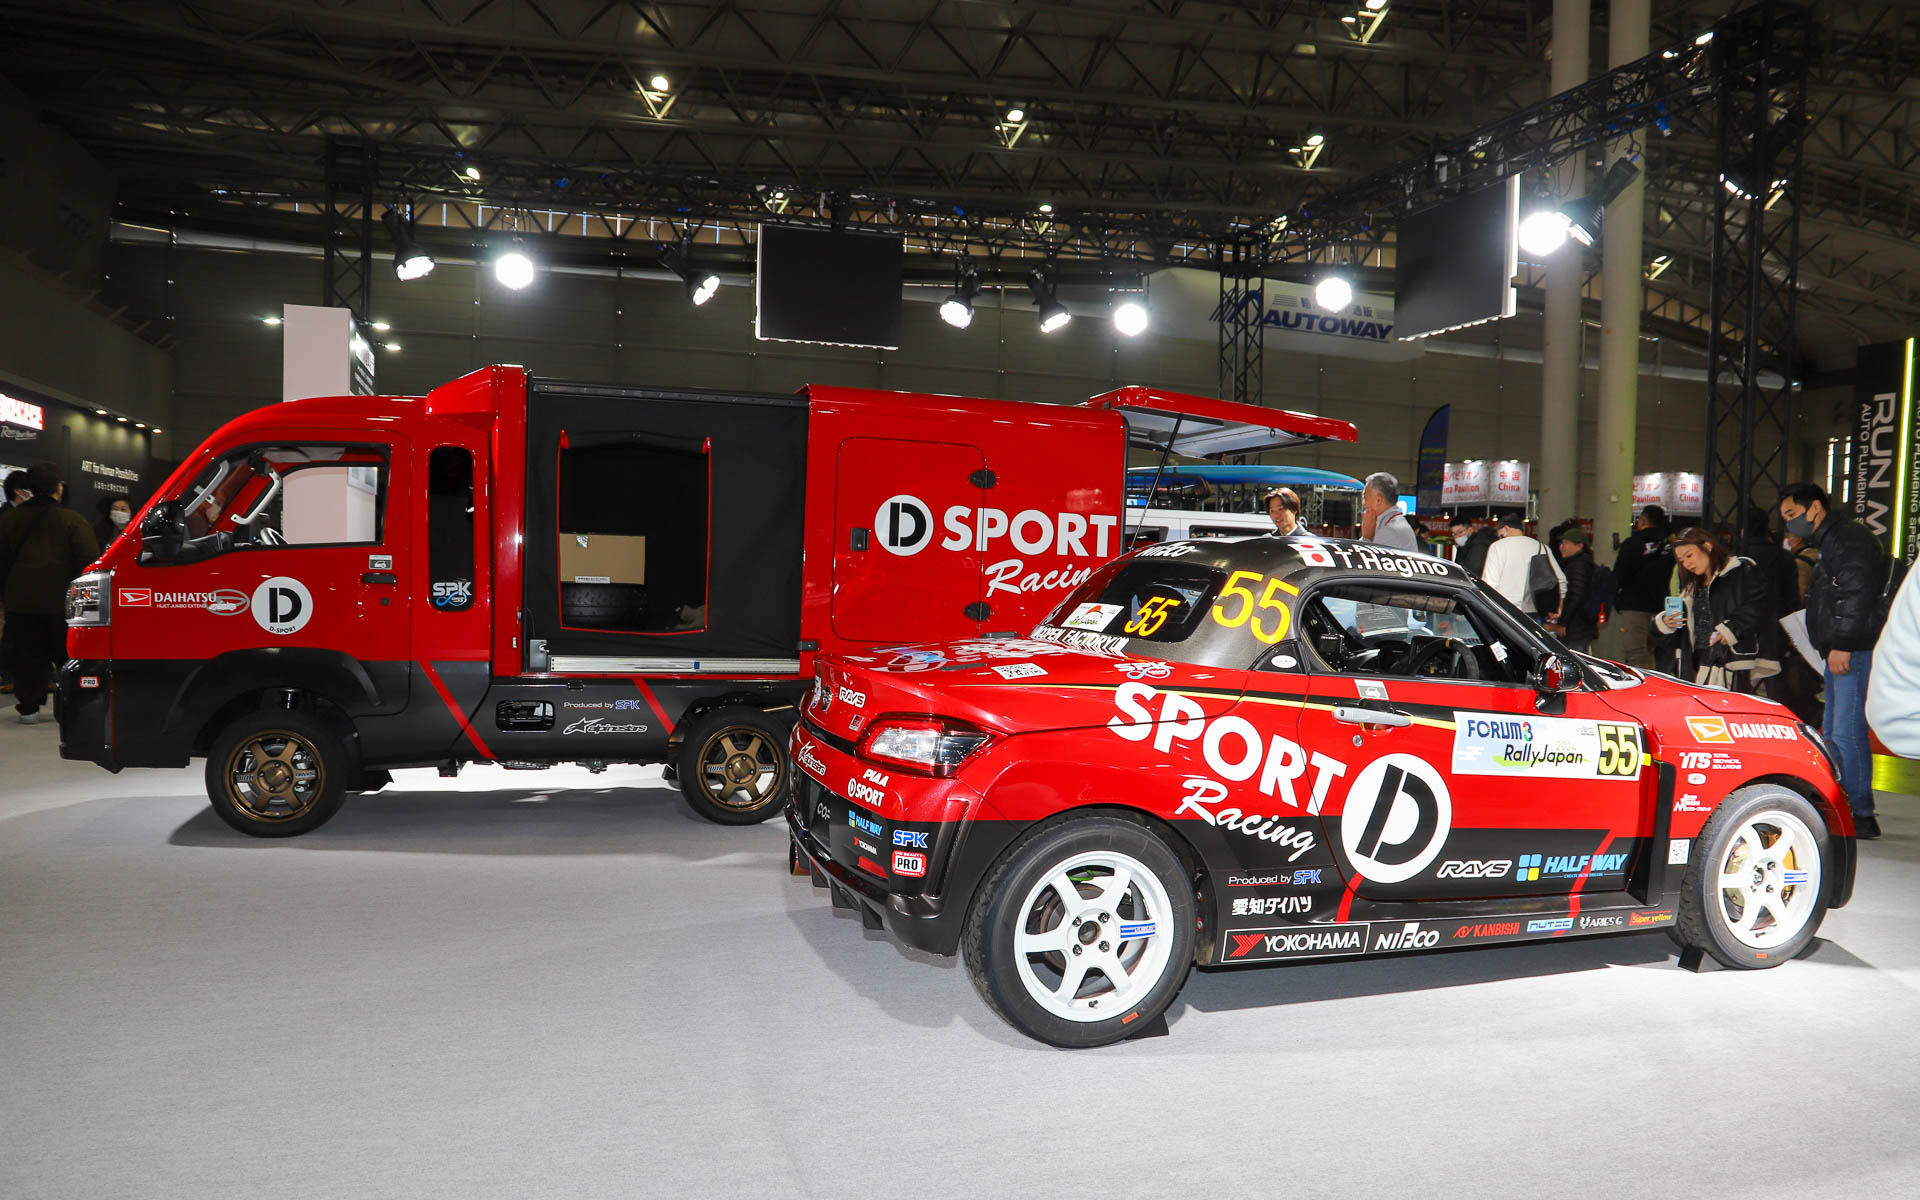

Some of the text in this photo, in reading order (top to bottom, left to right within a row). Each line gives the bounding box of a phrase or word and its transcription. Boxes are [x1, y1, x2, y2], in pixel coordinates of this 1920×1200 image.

[1262, 309, 1394, 340] AUTOWAY
[1860, 403, 1872, 442] AUTO
[1868, 392, 1897, 488] RUN
[1498, 481, 1521, 492] China
[1855, 445, 1869, 513] PLUMBING
[1911, 443, 1920, 513] PLUMBING
[1680, 493, 1700, 503] China
[941, 504, 1118, 558] SPORT
[1905, 516, 1917, 566] SPECIA
[1335, 551, 1449, 578] T.Hagino
[984, 558, 1092, 598] Racin
[154, 592, 217, 603] DAIHATSU
[432, 581, 472, 597] SPK
[1123, 596, 1182, 637] 55
[1211, 569, 1300, 645] 55
[269, 625, 297, 634] D-SPORT
[1113, 661, 1176, 672] SPK
[564, 700, 640, 709] Produced by SPK
[839, 686, 866, 708] RAYS
[1729, 722, 1798, 741] DAIHATSU
[1106, 681, 1348, 817] SPORT
[1598, 725, 1639, 776] 55
[862, 768, 890, 787] PIAA
[855, 783, 885, 807] SPORT
[856, 814, 883, 836] HALF WAY
[1174, 778, 1317, 863] Racing
[892, 829, 929, 849] SPK
[897, 857, 918, 871] PRO
[1436, 860, 1513, 879] RAYS
[1543, 853, 1629, 873] HALF WAY
[1228, 870, 1321, 885] Produced by SPK
[1231, 895, 1312, 916] 愛知ダイハツ
[1588, 917, 1615, 927] ARIES
[1631, 912, 1673, 924] Super yellow
[1473, 921, 1521, 938] KANBISHI
[1264, 931, 1361, 953] YOKOHAMA
